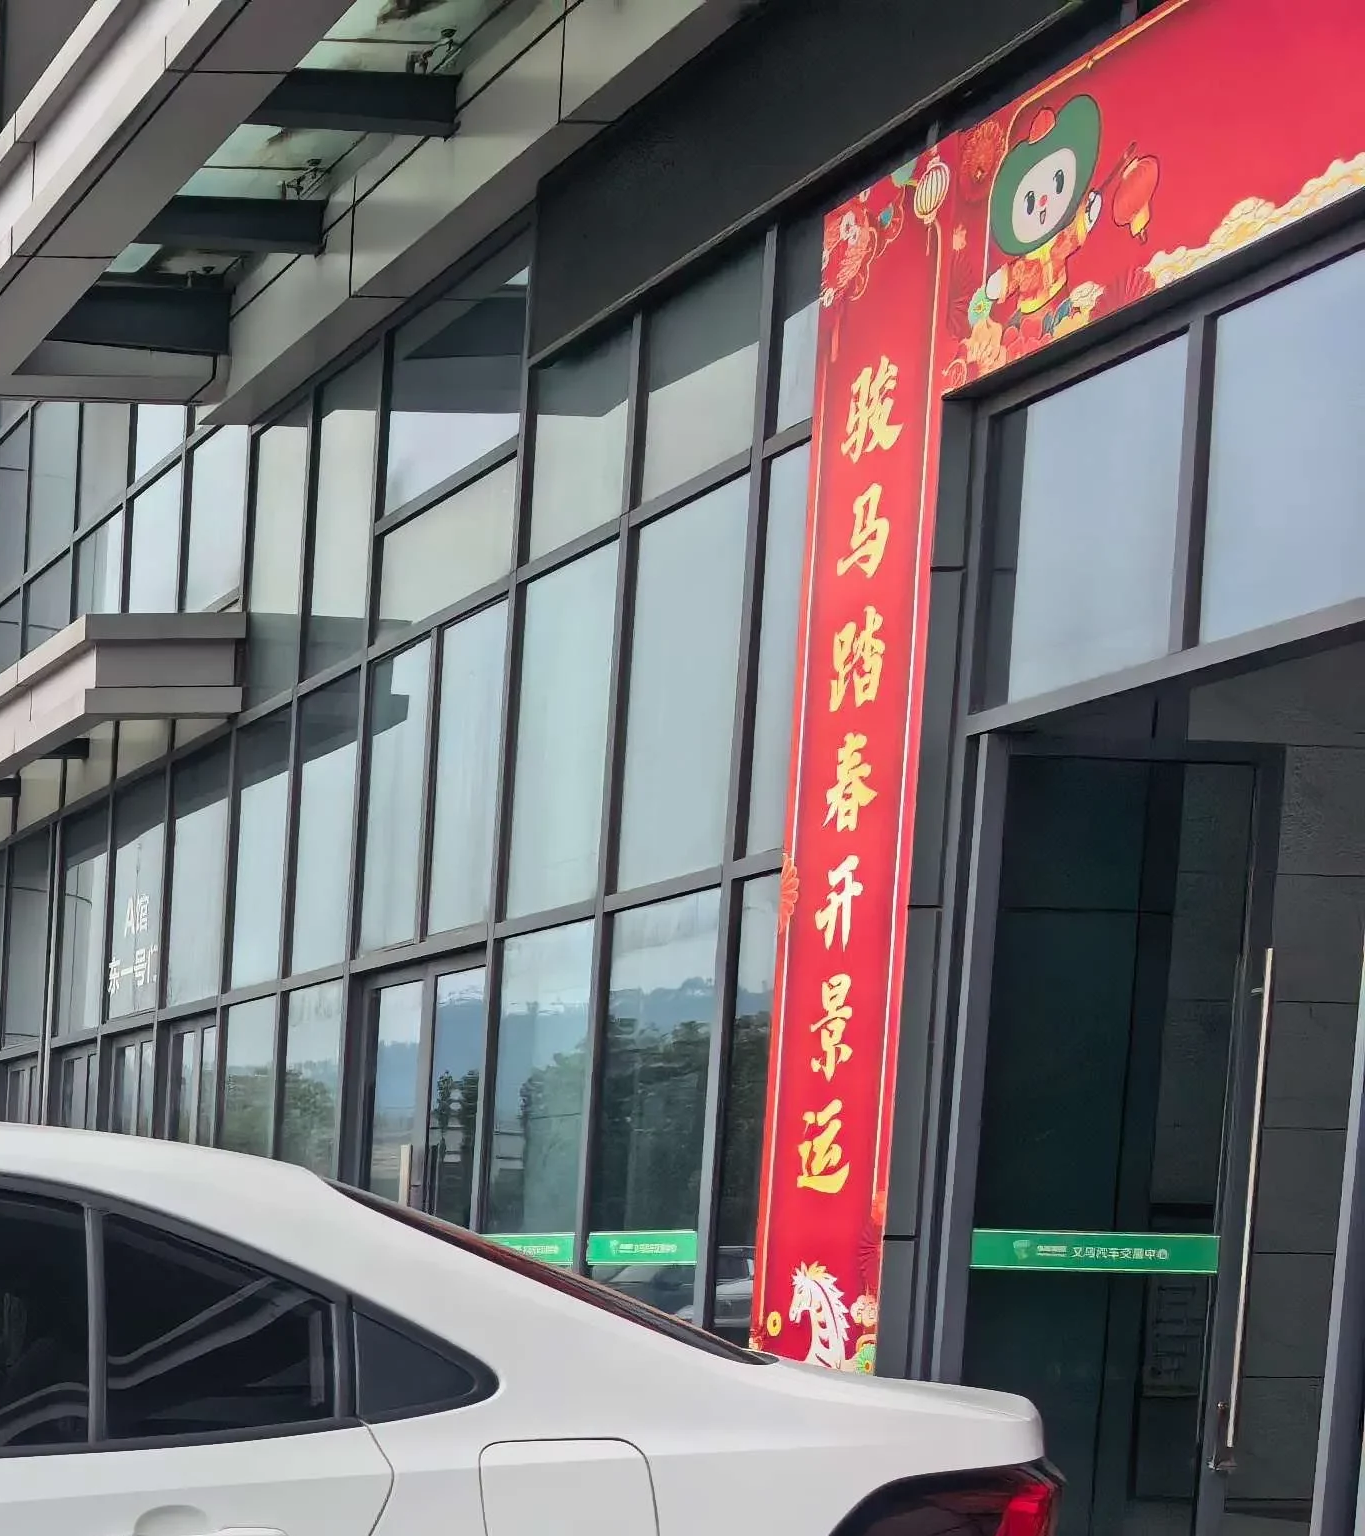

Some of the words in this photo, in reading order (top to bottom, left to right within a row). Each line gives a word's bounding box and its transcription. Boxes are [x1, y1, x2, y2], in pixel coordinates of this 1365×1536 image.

[124, 893, 150, 938] A馆
[797, 352, 904, 1192] 骏马踏春开景运
